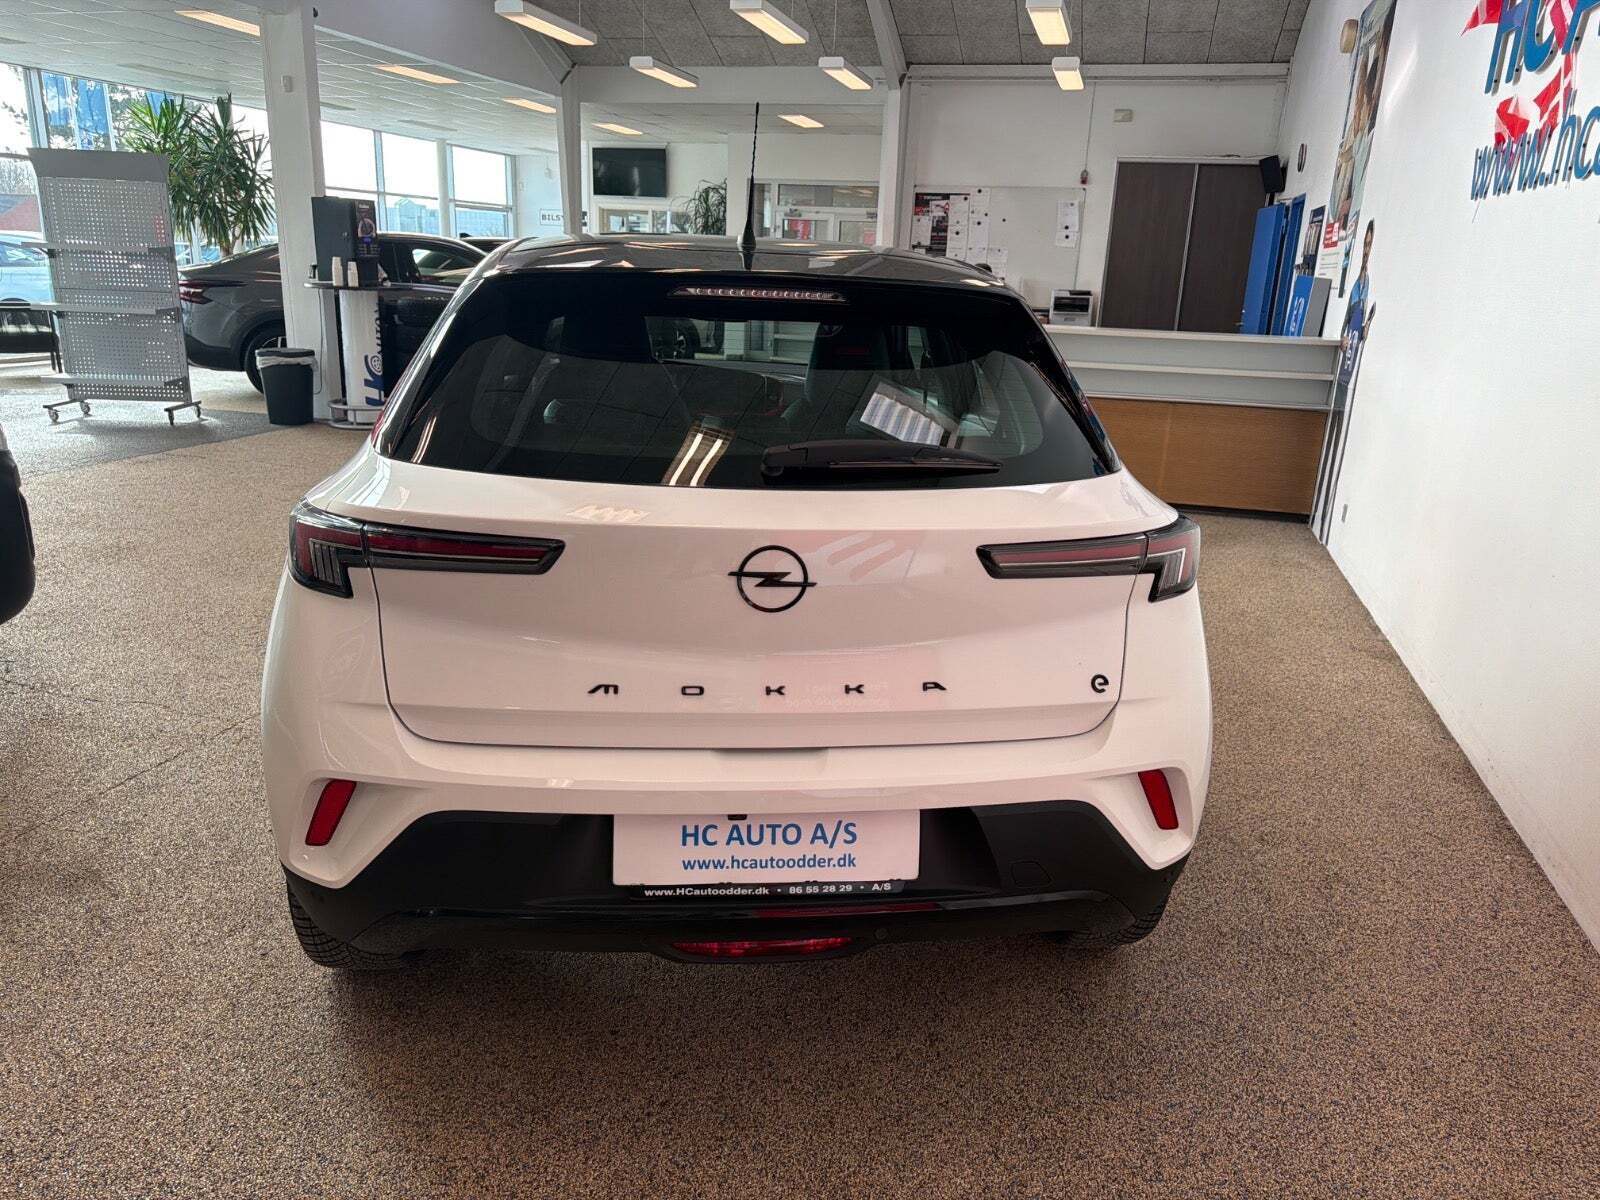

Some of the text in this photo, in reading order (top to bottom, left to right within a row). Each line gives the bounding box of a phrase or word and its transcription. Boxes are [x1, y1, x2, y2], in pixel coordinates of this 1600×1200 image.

[587, 682, 947, 696] MOKKA
[681, 820, 857, 849] HC AUTO A/S
[682, 853, 857, 870] www.hcautoodder.dk
[644, 886, 769, 897] www.HCautoodder.dk
[789, 886, 804, 895] 86
[822, 884, 836, 893] 28
[837, 884, 852, 893] 29
[872, 882, 892, 891] A/S
